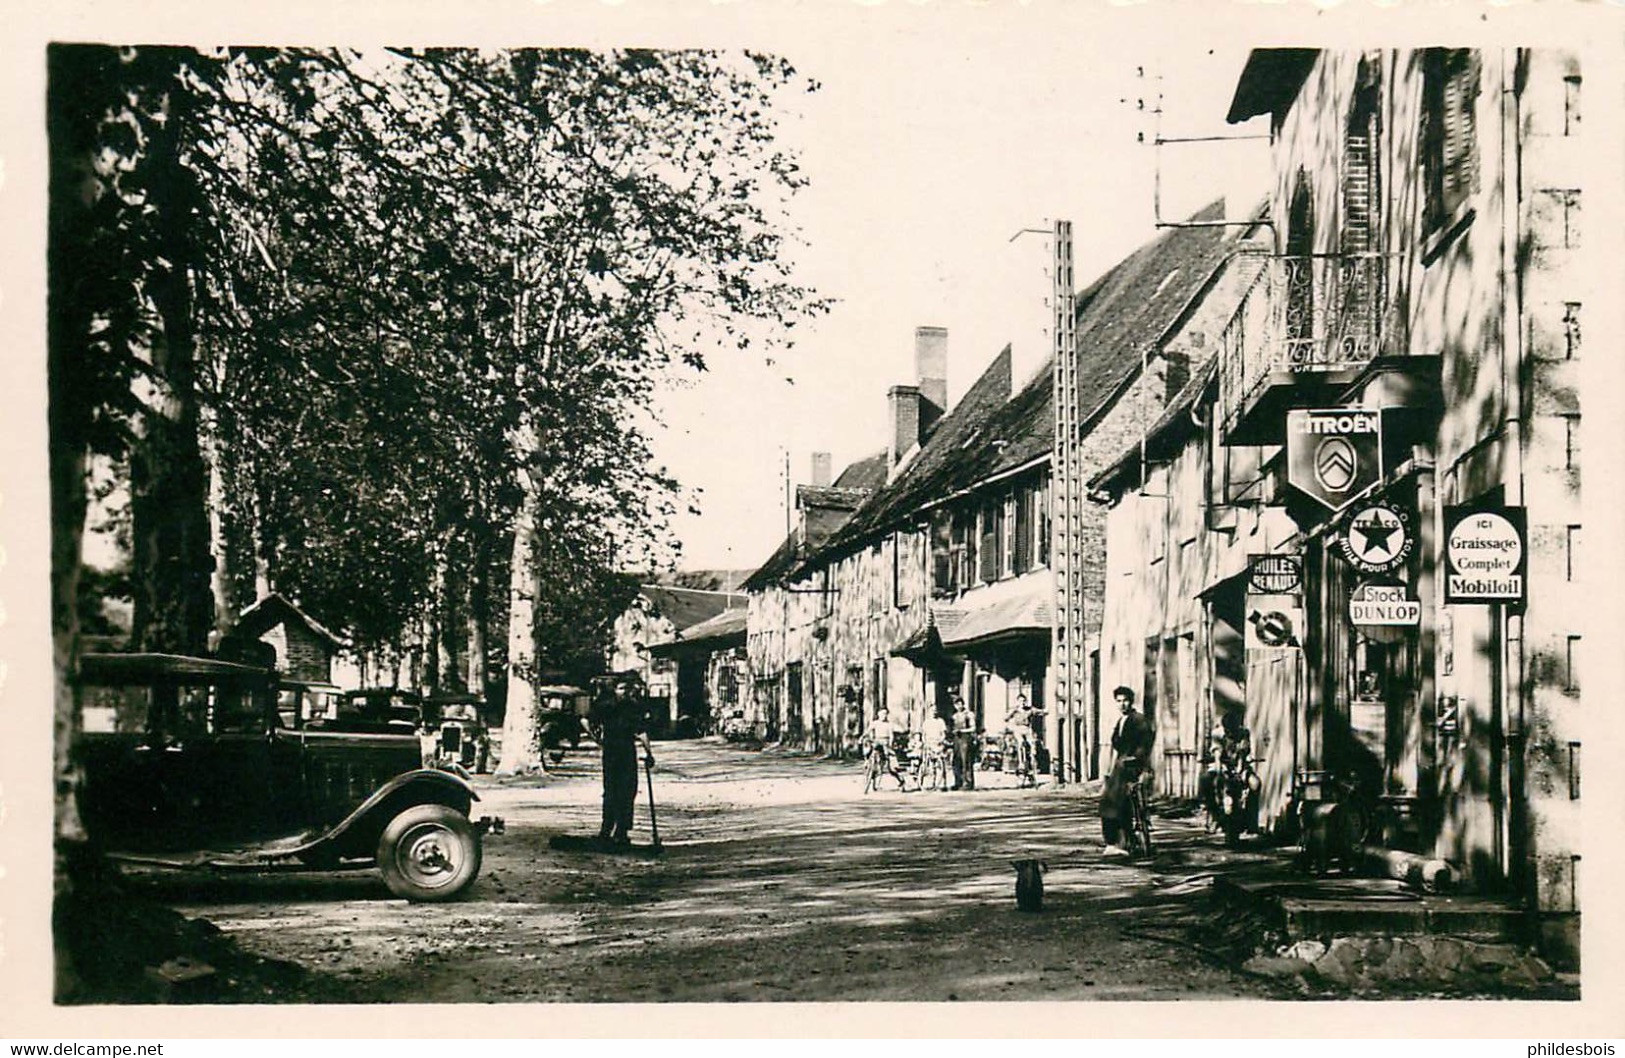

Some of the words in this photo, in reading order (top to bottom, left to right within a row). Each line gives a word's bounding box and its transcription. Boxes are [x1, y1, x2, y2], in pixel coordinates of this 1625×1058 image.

[1477, 520, 1493, 529] ICI
[1450, 536, 1517, 553] Graissage
[1339, 537, 1361, 566] HUILE
[1360, 562, 1388, 573] POUR
[1391, 538, 1414, 569] AUTOS
[1255, 559, 1296, 574] HUILES
[1457, 557, 1511, 573] Complet
[1252, 574, 1298, 592] RENAULT
[1452, 579, 1519, 594] Mobiloil
[1366, 587, 1404, 603] Stock
[1353, 606, 1418, 621] DUNLOP
